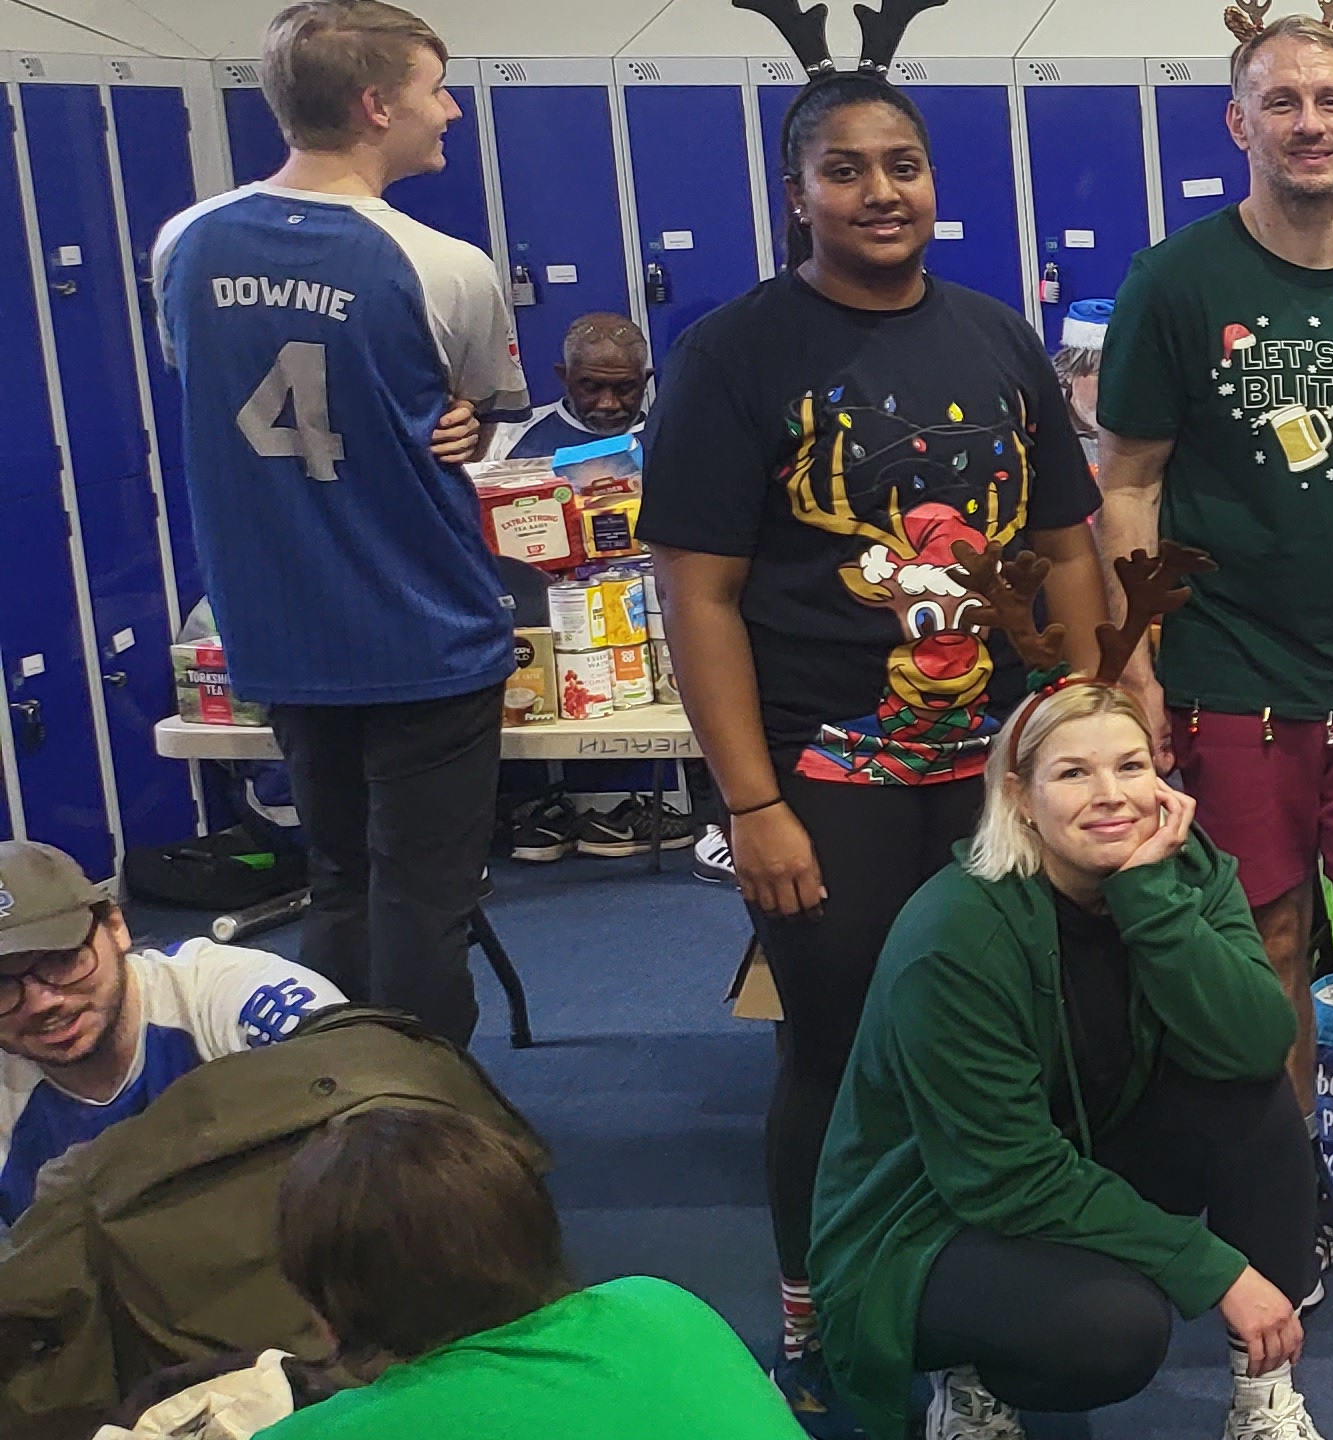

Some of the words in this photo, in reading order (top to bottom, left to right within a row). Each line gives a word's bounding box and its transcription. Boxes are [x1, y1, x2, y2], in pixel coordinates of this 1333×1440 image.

[212, 276, 356, 322] DOWNIE
[236, 341, 346, 482] 4
[501, 516, 528, 530] EXTRA
[527, 513, 559, 524] STRONG
[205, 684, 224, 696] TEA
[577, 737, 692, 755] HEALTH
